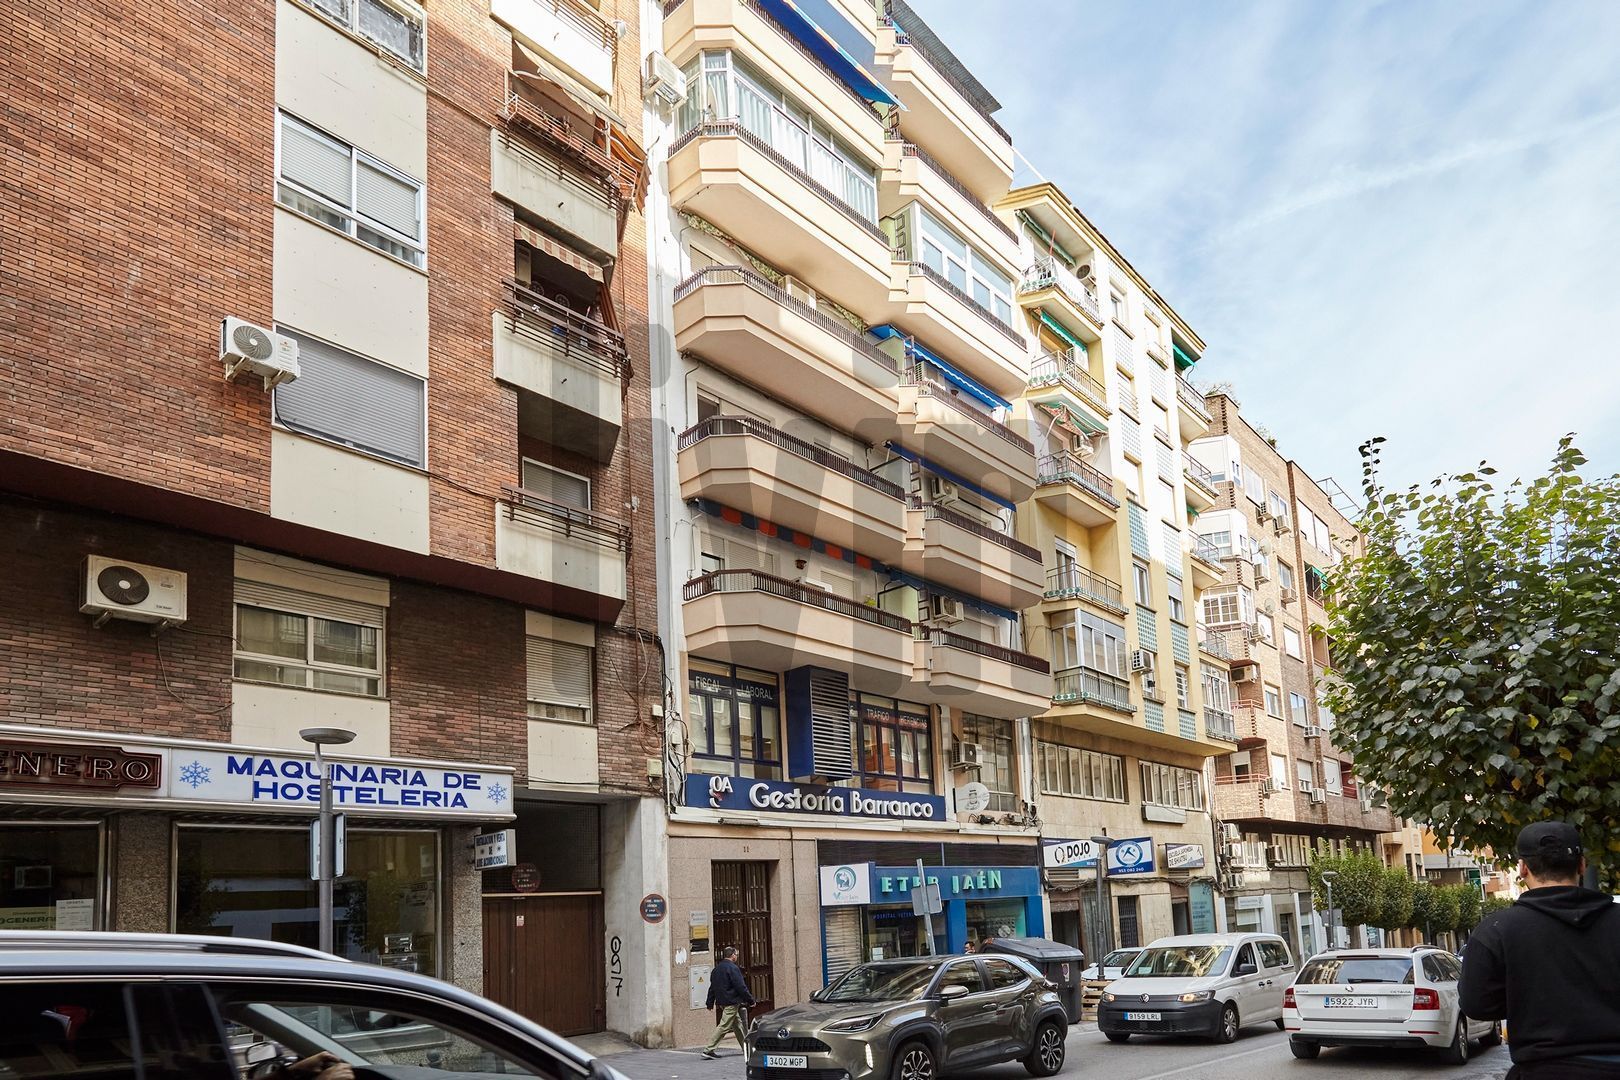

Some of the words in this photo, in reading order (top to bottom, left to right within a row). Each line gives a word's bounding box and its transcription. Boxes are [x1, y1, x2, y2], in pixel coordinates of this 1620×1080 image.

[695, 676, 721, 691] FISCAL
[741, 684, 773, 700] LABORAL
[227, 755, 428, 787] MAQUINARIA
[443, 772, 482, 790] DE
[253, 780, 469, 808] HOSTELERIA
[749, 781, 845, 813] Gestoría
[850, 789, 934, 818] Barranco
[1066, 842, 1091, 859] DOJO
[951, 870, 1002, 894] JAÉN
[1330, 997, 1354, 1006] 5922
[1357, 997, 1374, 1006] JYR
[769, 1057, 788, 1066] 3402
[789, 1057, 804, 1067] MGP
